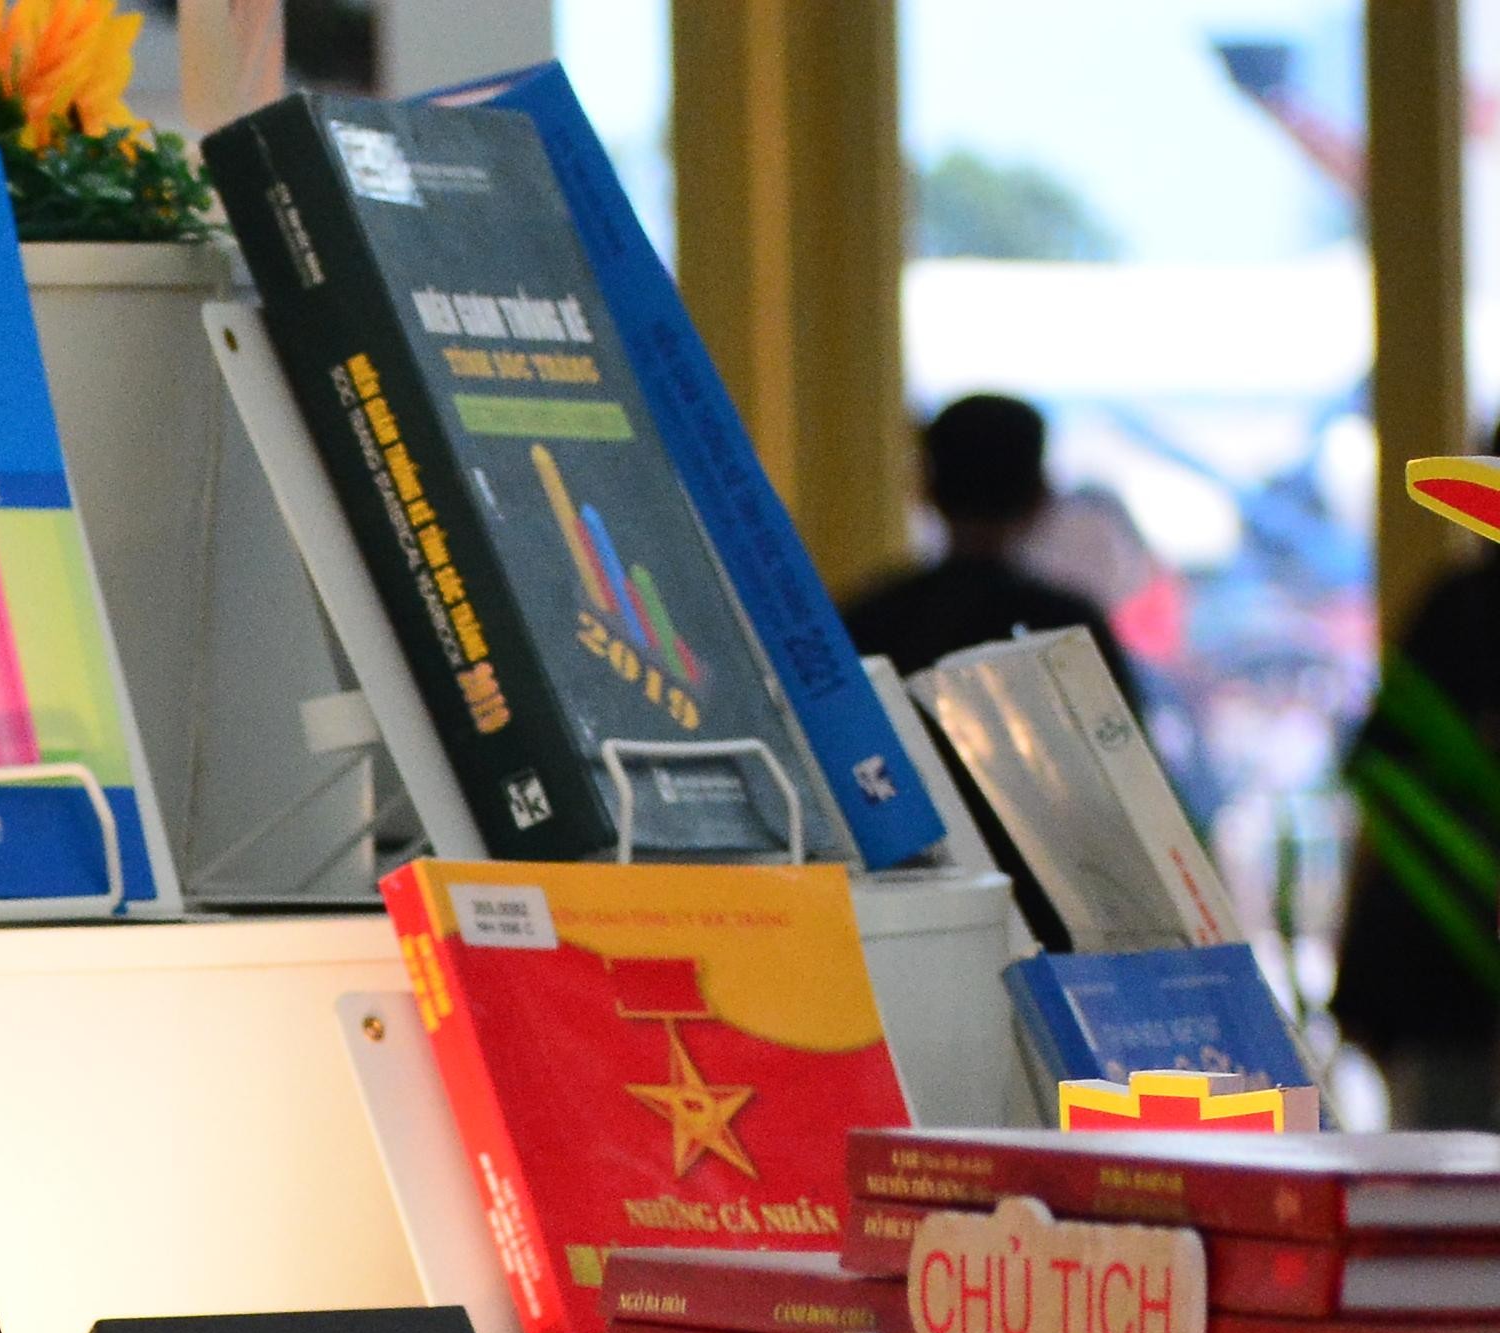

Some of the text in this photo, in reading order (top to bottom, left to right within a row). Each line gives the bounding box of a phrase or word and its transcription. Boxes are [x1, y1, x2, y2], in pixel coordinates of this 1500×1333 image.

[577, 610, 700, 731] 2019
[719, 1197, 761, 1232] CÁ
[761, 1196, 839, 1234] NHÂN
